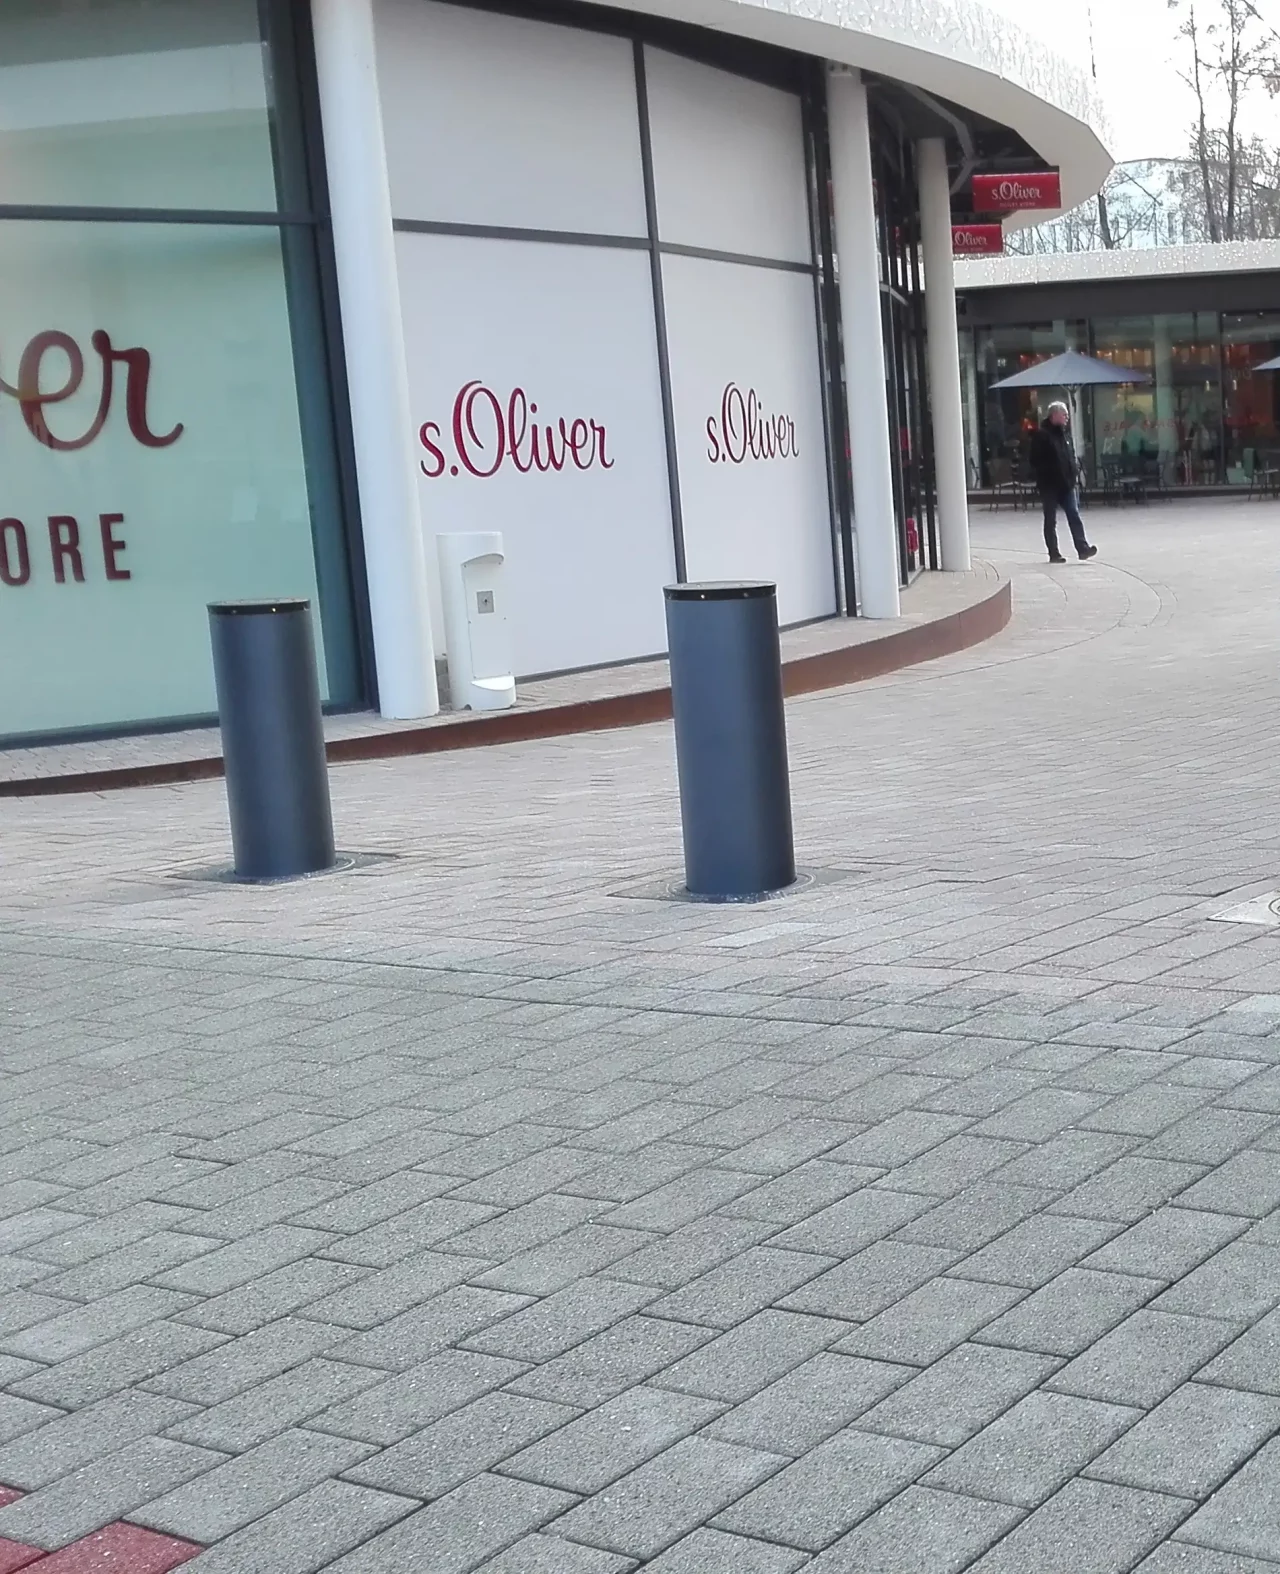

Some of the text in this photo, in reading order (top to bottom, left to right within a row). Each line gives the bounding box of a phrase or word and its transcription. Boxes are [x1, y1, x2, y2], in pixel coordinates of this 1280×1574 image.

[991, 181, 1042, 201] s.Oliver
[0, 329, 184, 451] er
[419, 380, 614, 478] s.Oliver
[706, 382, 800, 464] s.Oliver
